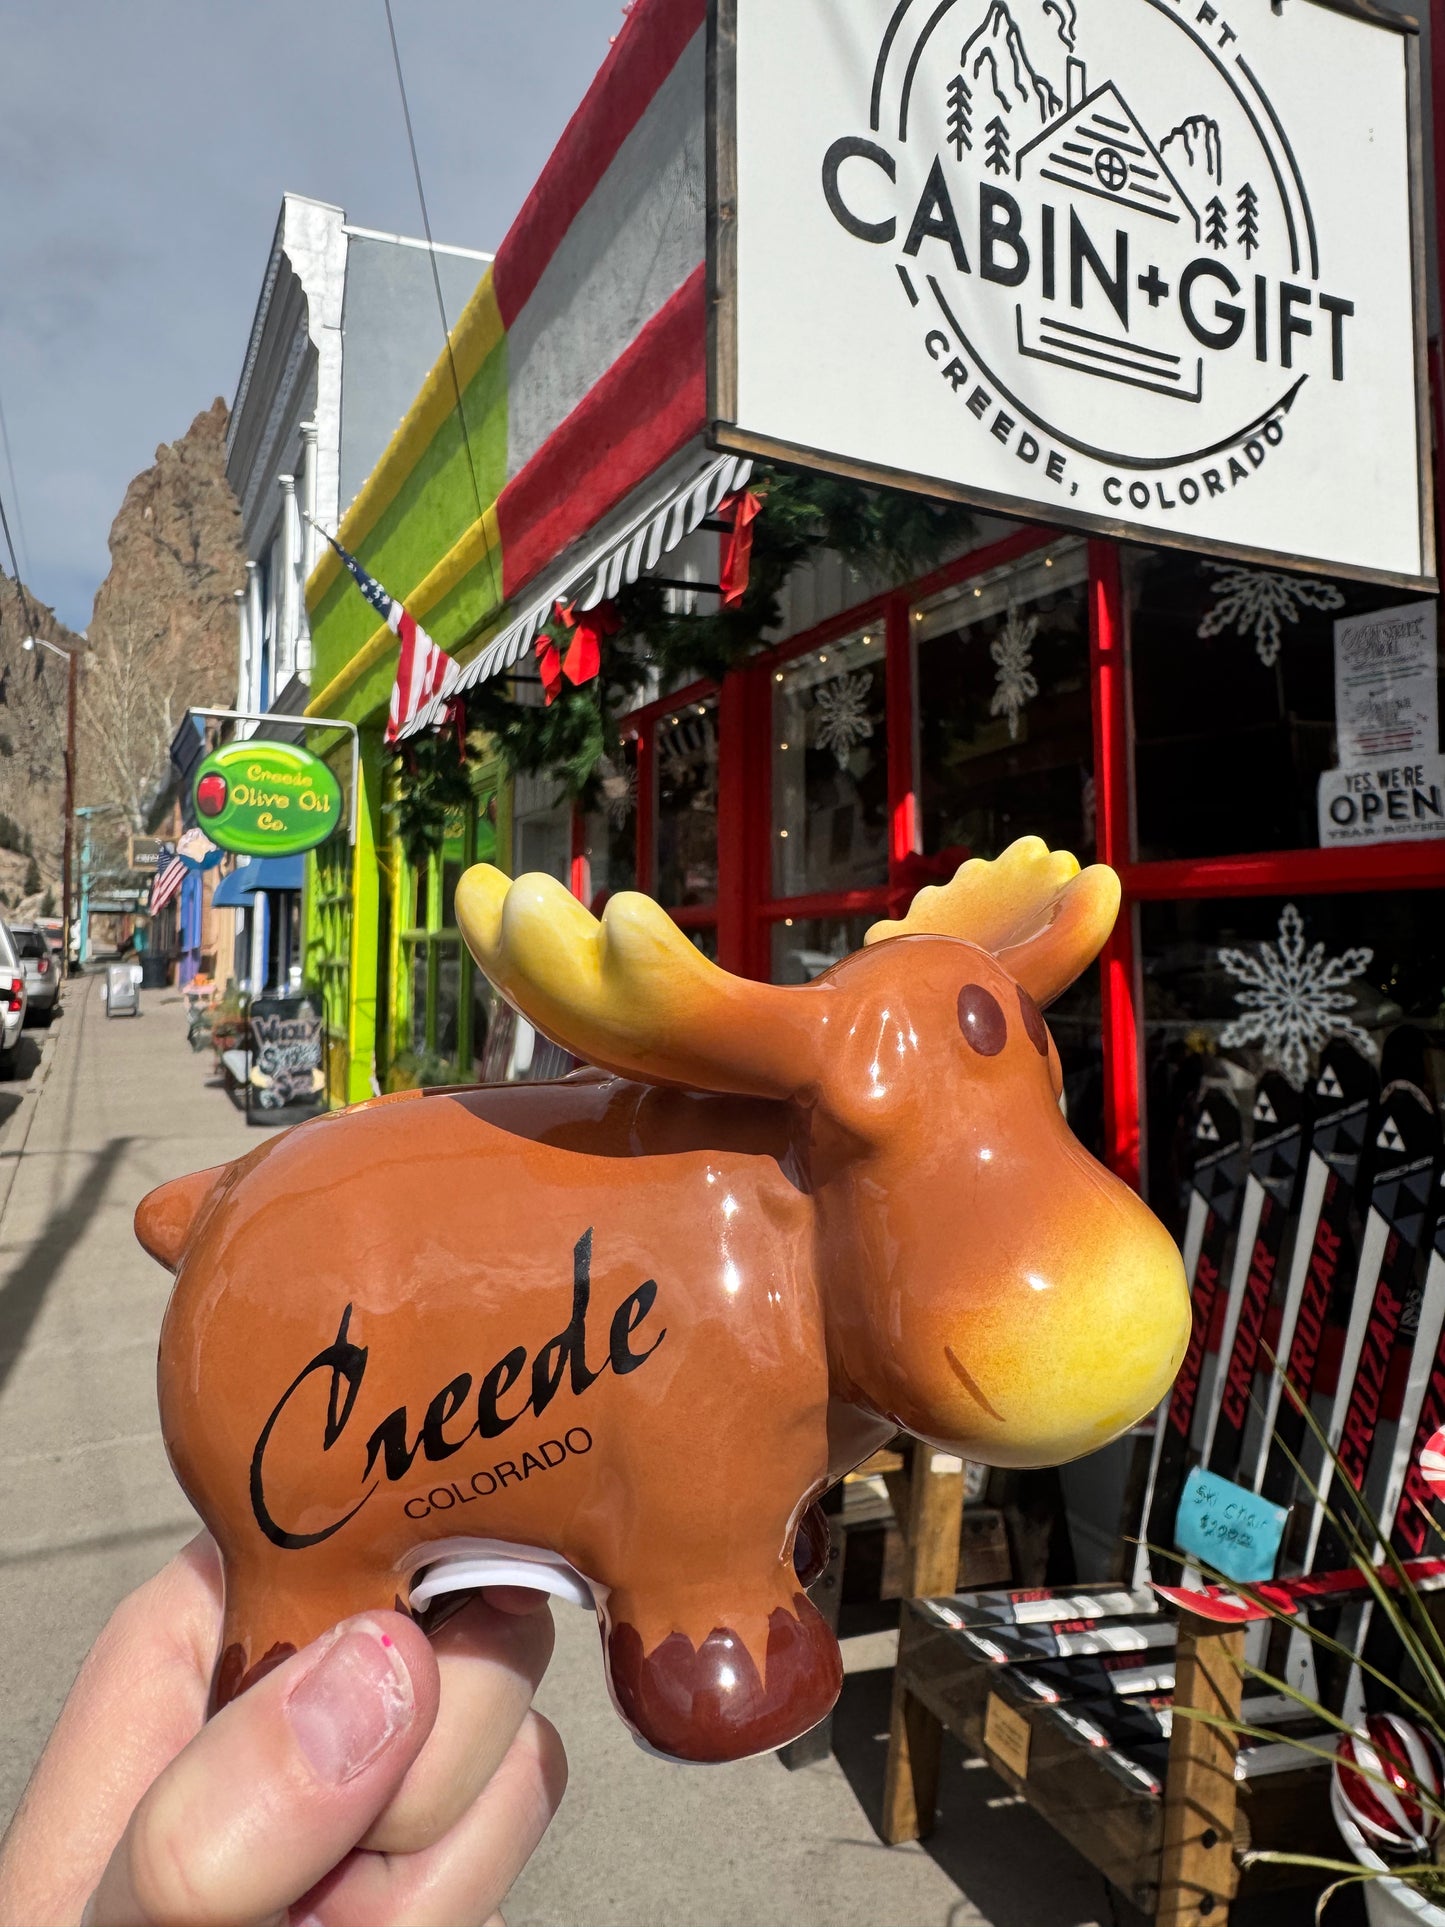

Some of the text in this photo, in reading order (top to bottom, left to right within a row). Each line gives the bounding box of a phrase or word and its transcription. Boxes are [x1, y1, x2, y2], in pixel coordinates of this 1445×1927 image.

[924, 329, 1285, 510] CREEDE, COLORADO
[229, 783, 331, 813] Olive Oil
[246, 764, 313, 788] Creede
[1329, 784, 1443, 826] OPEN
[256, 811, 288, 832] Co.
[1223, 1237, 1275, 1431] CRUZAR
[249, 1225, 668, 1550] Creede
[403, 1425, 594, 1520] COLORADO
